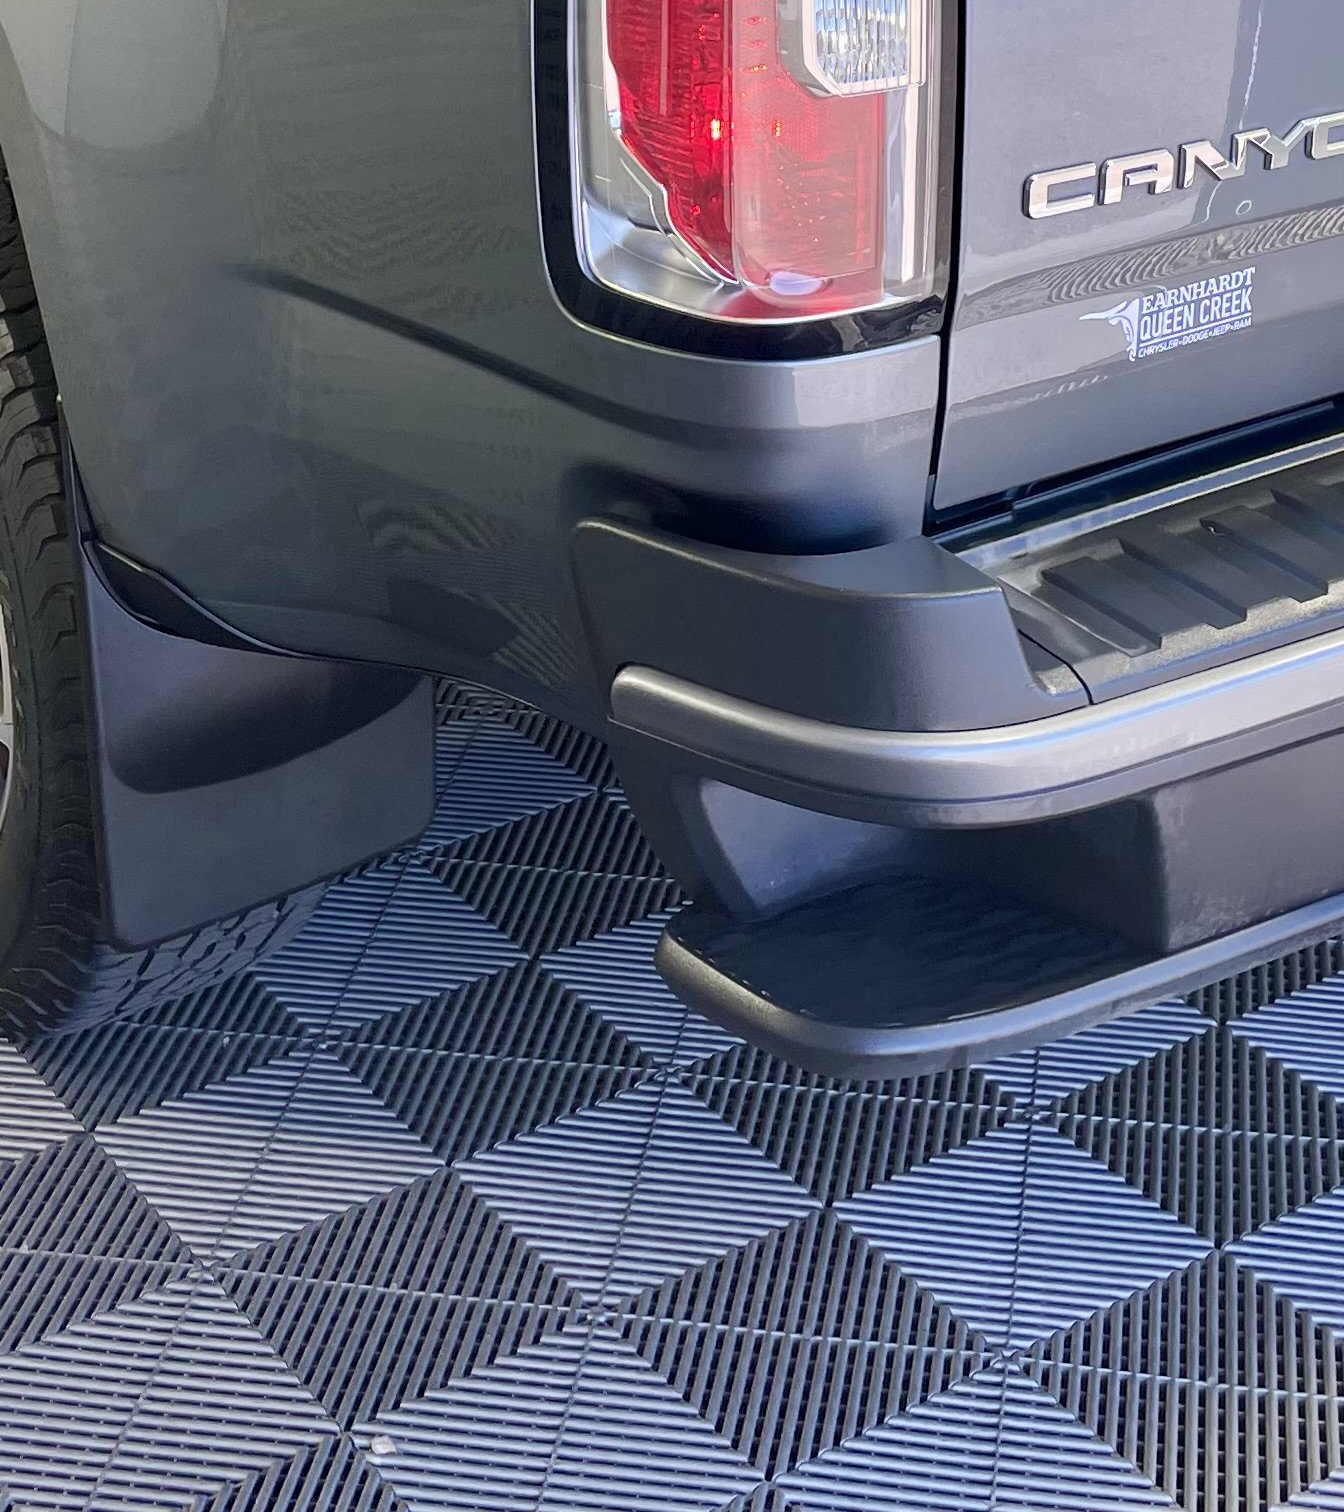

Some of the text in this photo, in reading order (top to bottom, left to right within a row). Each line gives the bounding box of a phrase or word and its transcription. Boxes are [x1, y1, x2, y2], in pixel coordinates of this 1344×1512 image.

[1139, 287, 1253, 340] QUEEN CREEK
[1141, 267, 1256, 315] EARNHARDT
